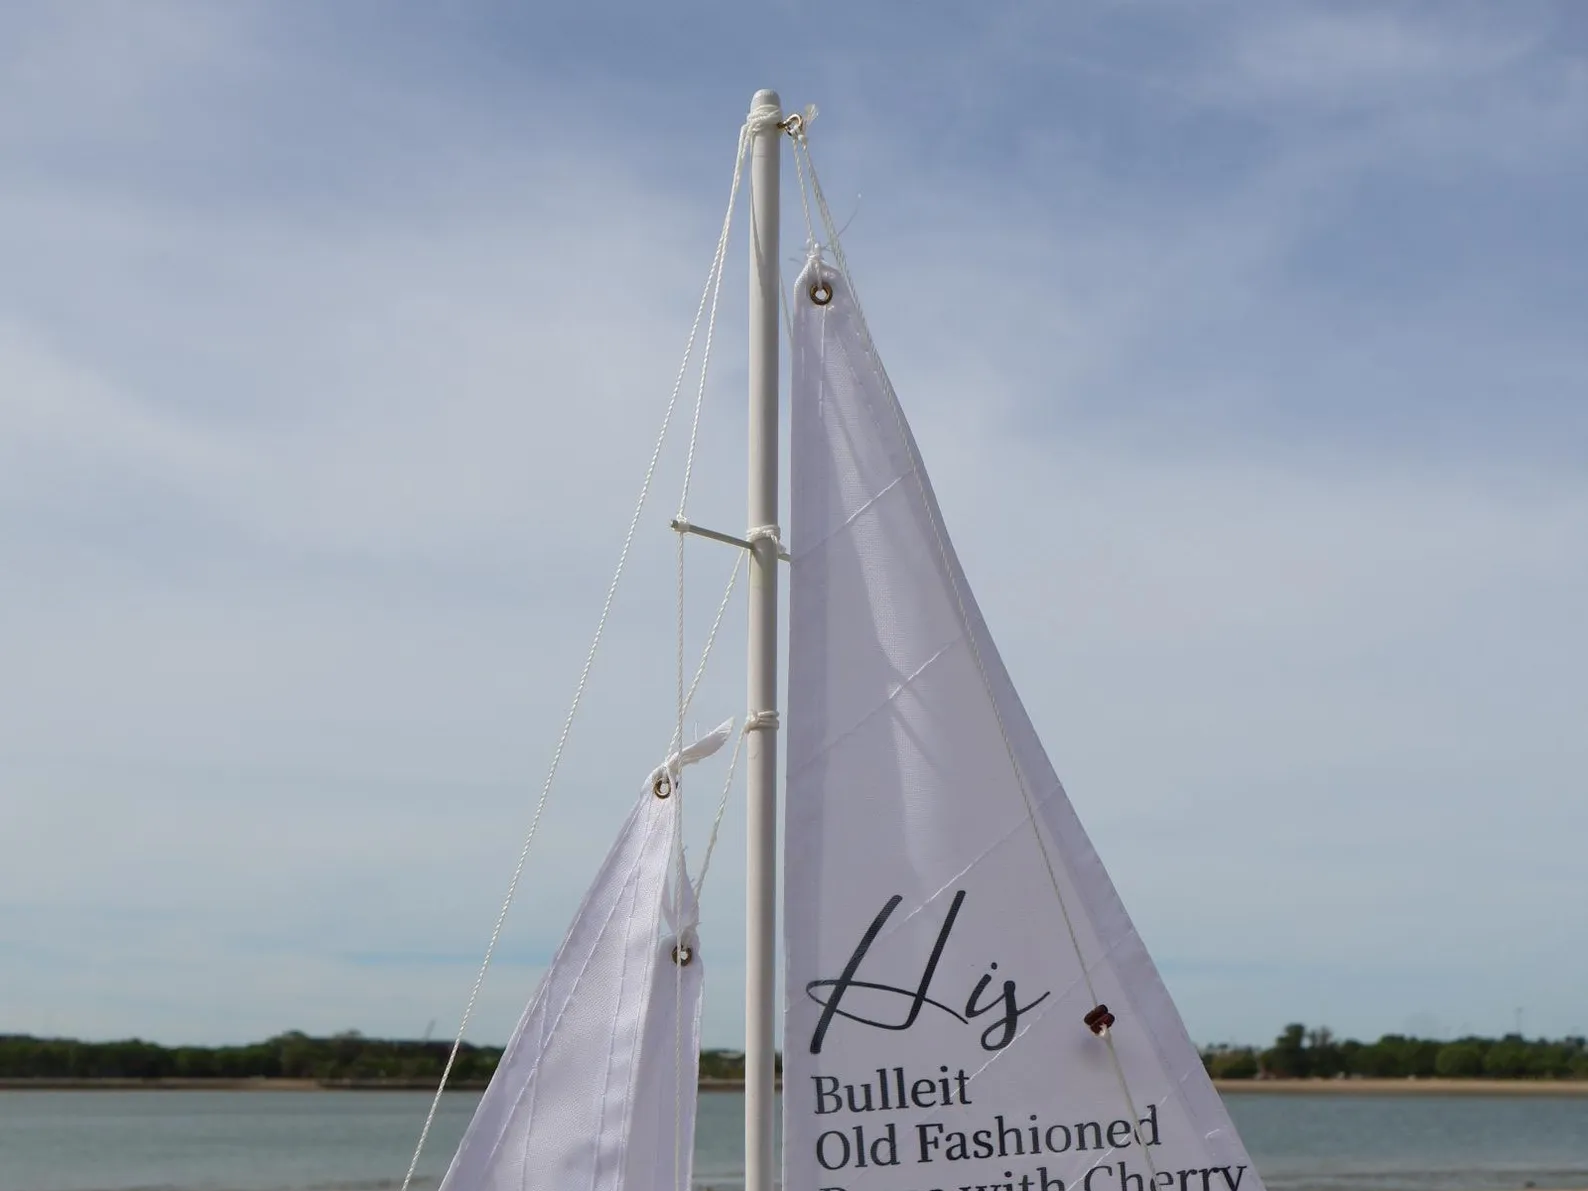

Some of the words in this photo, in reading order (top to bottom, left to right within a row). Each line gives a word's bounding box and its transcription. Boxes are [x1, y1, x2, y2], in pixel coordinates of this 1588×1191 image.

[806, 890, 1050, 1054] His
[810, 1065, 972, 1115] Bulleit
[815, 1123, 900, 1171] Old
[916, 1105, 1162, 1164] Fashioned
